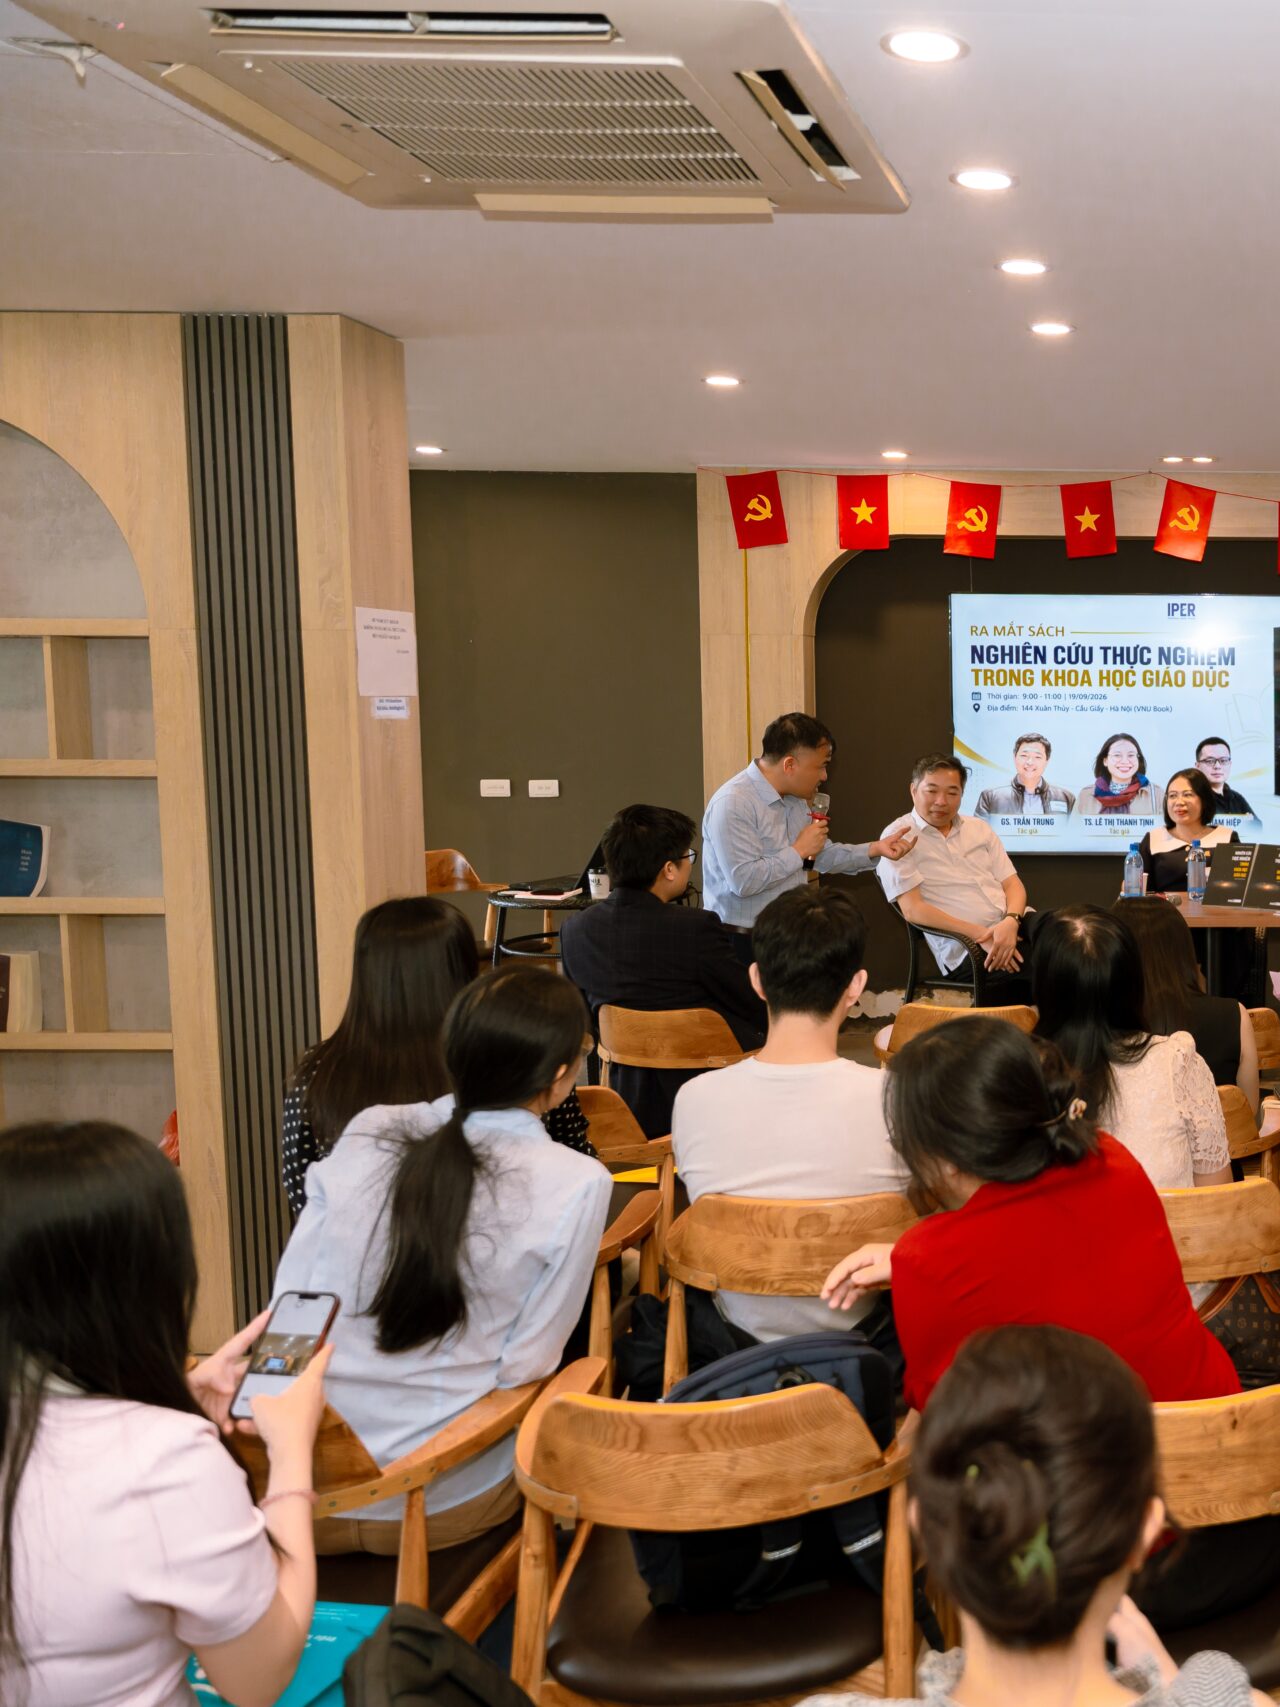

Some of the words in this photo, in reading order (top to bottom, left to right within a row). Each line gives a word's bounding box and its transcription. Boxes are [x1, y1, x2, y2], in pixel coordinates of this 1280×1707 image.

[1167, 602, 1196, 617] IPER
[970, 625, 989, 637] RA
[993, 621, 1024, 637] MẮT
[1028, 623, 1065, 637] SÁCH
[970, 641, 1047, 665] NGHIÊN
[1053, 641, 1093, 665] CỨU
[1099, 644, 1152, 669] THỰC
[970, 668, 1035, 687] TRONG
[1041, 668, 1093, 687] KHOA
[1098, 668, 1137, 691] HỌC
[1142, 666, 1186, 688] GIÁO
[1192, 669, 1230, 692] DỤC
[1003, 693, 1019, 702] gian:
[1068, 693, 1108, 701] 19/09/2026
[1133, 705, 1152, 713] (VNU
[1153, 705, 1173, 713] Book)
[1000, 817, 1011, 826] GS.
[1013, 816, 1031, 826] TRẦN
[1032, 817, 1055, 826] TRUNG
[1084, 818, 1094, 826] TS.
[1095, 817, 1102, 826] LÊ
[1116, 818, 1138, 826] THANH
[1225, 817, 1242, 827] HIỆP
